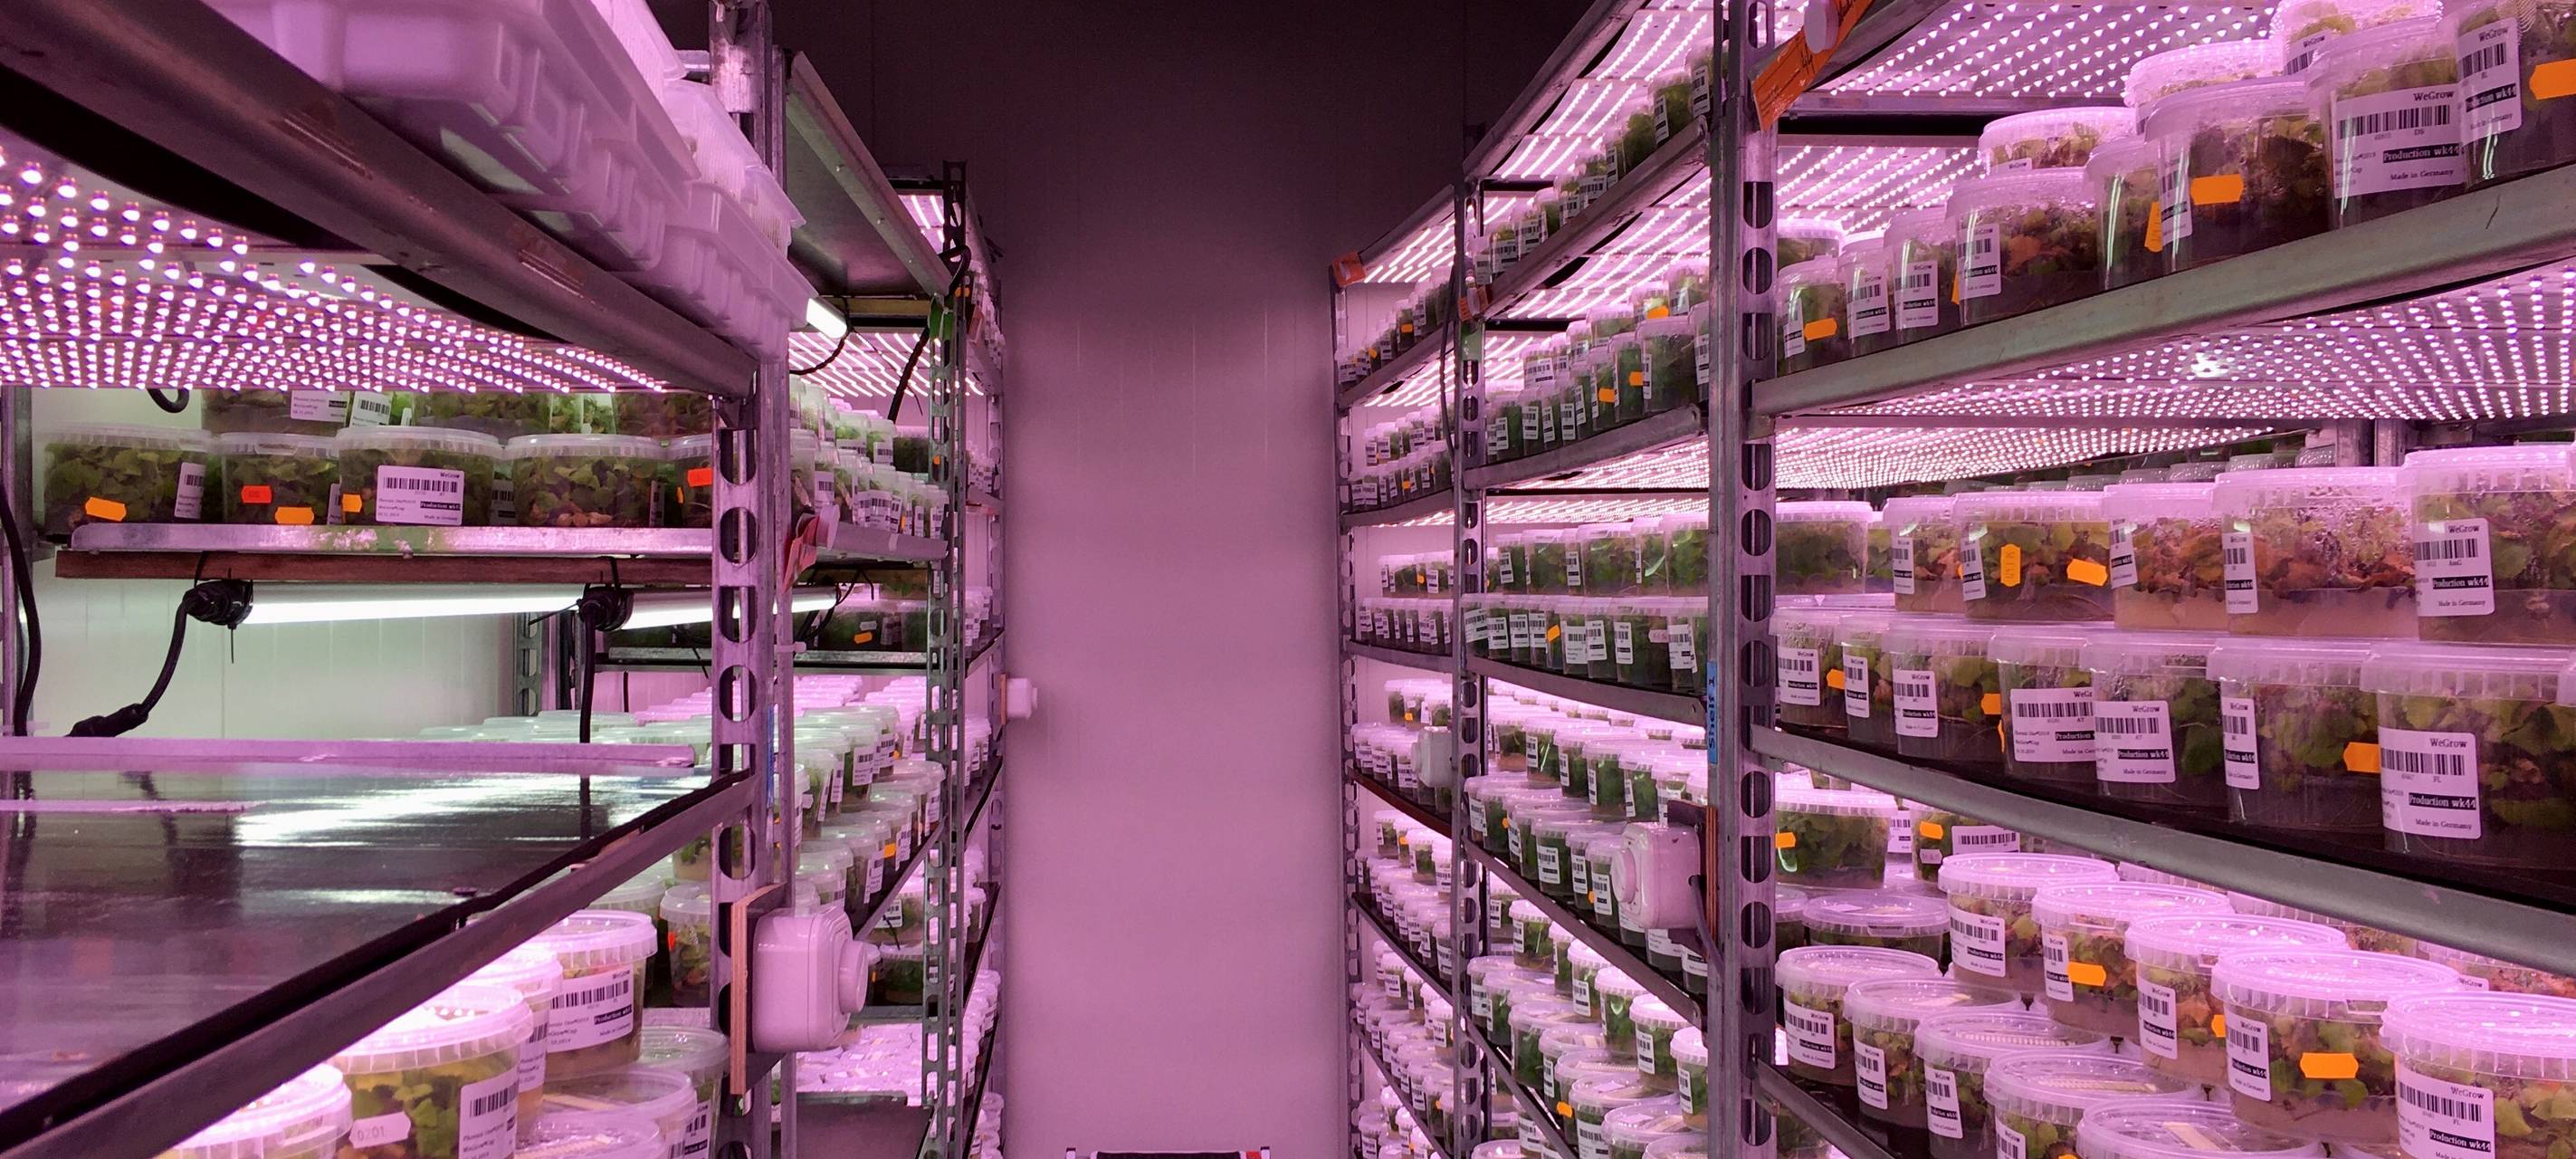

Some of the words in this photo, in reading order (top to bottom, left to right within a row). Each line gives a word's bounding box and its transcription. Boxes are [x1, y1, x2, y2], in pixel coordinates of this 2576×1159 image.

[2413, 91, 2455, 101] WeGrow
[2383, 148, 2431, 162] Production
[2419, 169, 2455, 178] Germany
[2448, 525, 2479, 533] WeGrow
[2467, 577, 2489, 587] wk44
[1708, 694, 1716, 749] Shelf
[2056, 732, 2090, 741] Production
[2429, 738, 2467, 748] WeGrow
[2118, 750, 2149, 758] Production
[2409, 795, 2449, 807] Production
[2451, 798, 2476, 808] wk44
[2416, 819, 2431, 827] Made
[2441, 820, 2473, 830] Germany
[2450, 1086, 2485, 1099] WeGrow
[2429, 1129, 2467, 1147] Production
[2468, 1138, 2491, 1152] wk44
